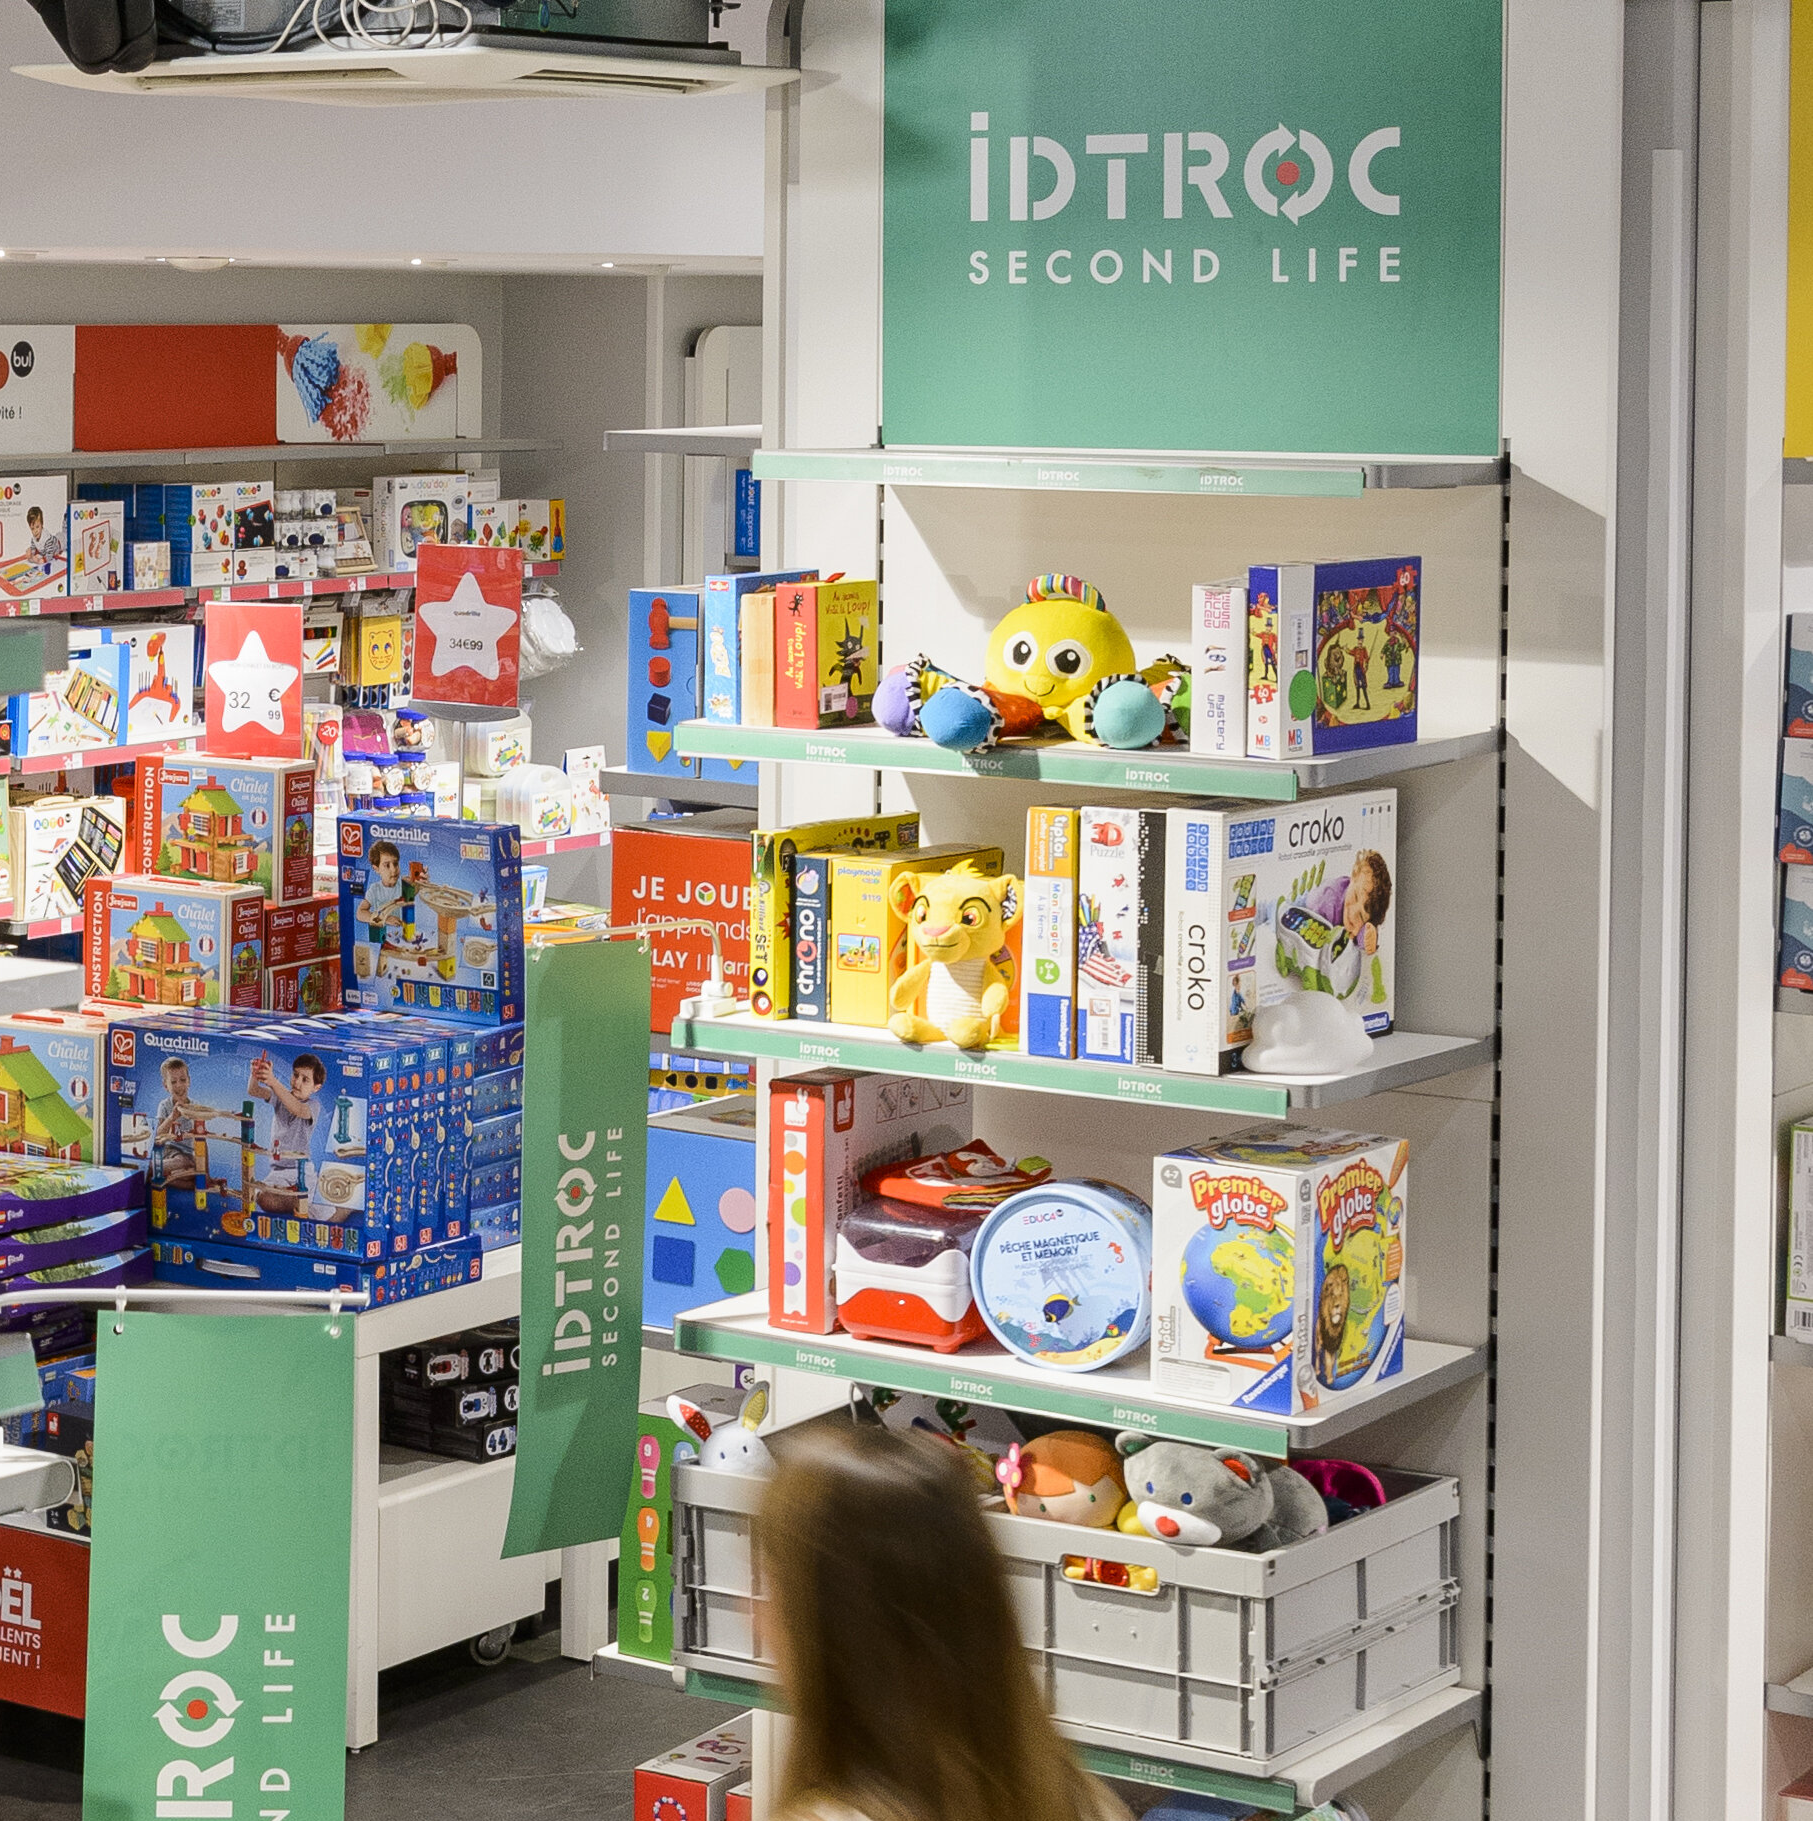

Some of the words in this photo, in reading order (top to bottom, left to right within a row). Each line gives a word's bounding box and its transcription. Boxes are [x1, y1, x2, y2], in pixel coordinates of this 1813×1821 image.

[969, 248, 1220, 285] SECOND
[1271, 247, 1400, 282] LIFE
[143, 766, 155, 876] CONSTRUCTION
[370, 824, 430, 843] Quadrilla
[1091, 822, 1124, 846] 3D
[1290, 809, 1343, 848] croko
[838, 867, 882, 878] playmobil
[632, 876, 665, 901] JE
[178, 904, 215, 922] Chalet
[1187, 924, 1212, 1010] croko
[48, 1040, 91, 1062] Chalet
[144, 1032, 209, 1052] Quadrilla
[607, 1125, 623, 1197] LIFE
[1193, 1177, 1283, 1209] Premier
[1321, 1161, 1381, 1212] Premier
[1211, 1195, 1268, 1224] globe
[1333, 1189, 1371, 1244] globe
[1000, 1239, 1035, 1256] PÊCHE
[1037, 1231, 1100, 1252] MAGNÉTIQUE
[1022, 1251, 1032, 1262] ET
[1034, 1246, 1079, 1261] MEMORY
[602, 1226, 620, 1367] SECOND
[262, 1614, 296, 1724] LIFE
